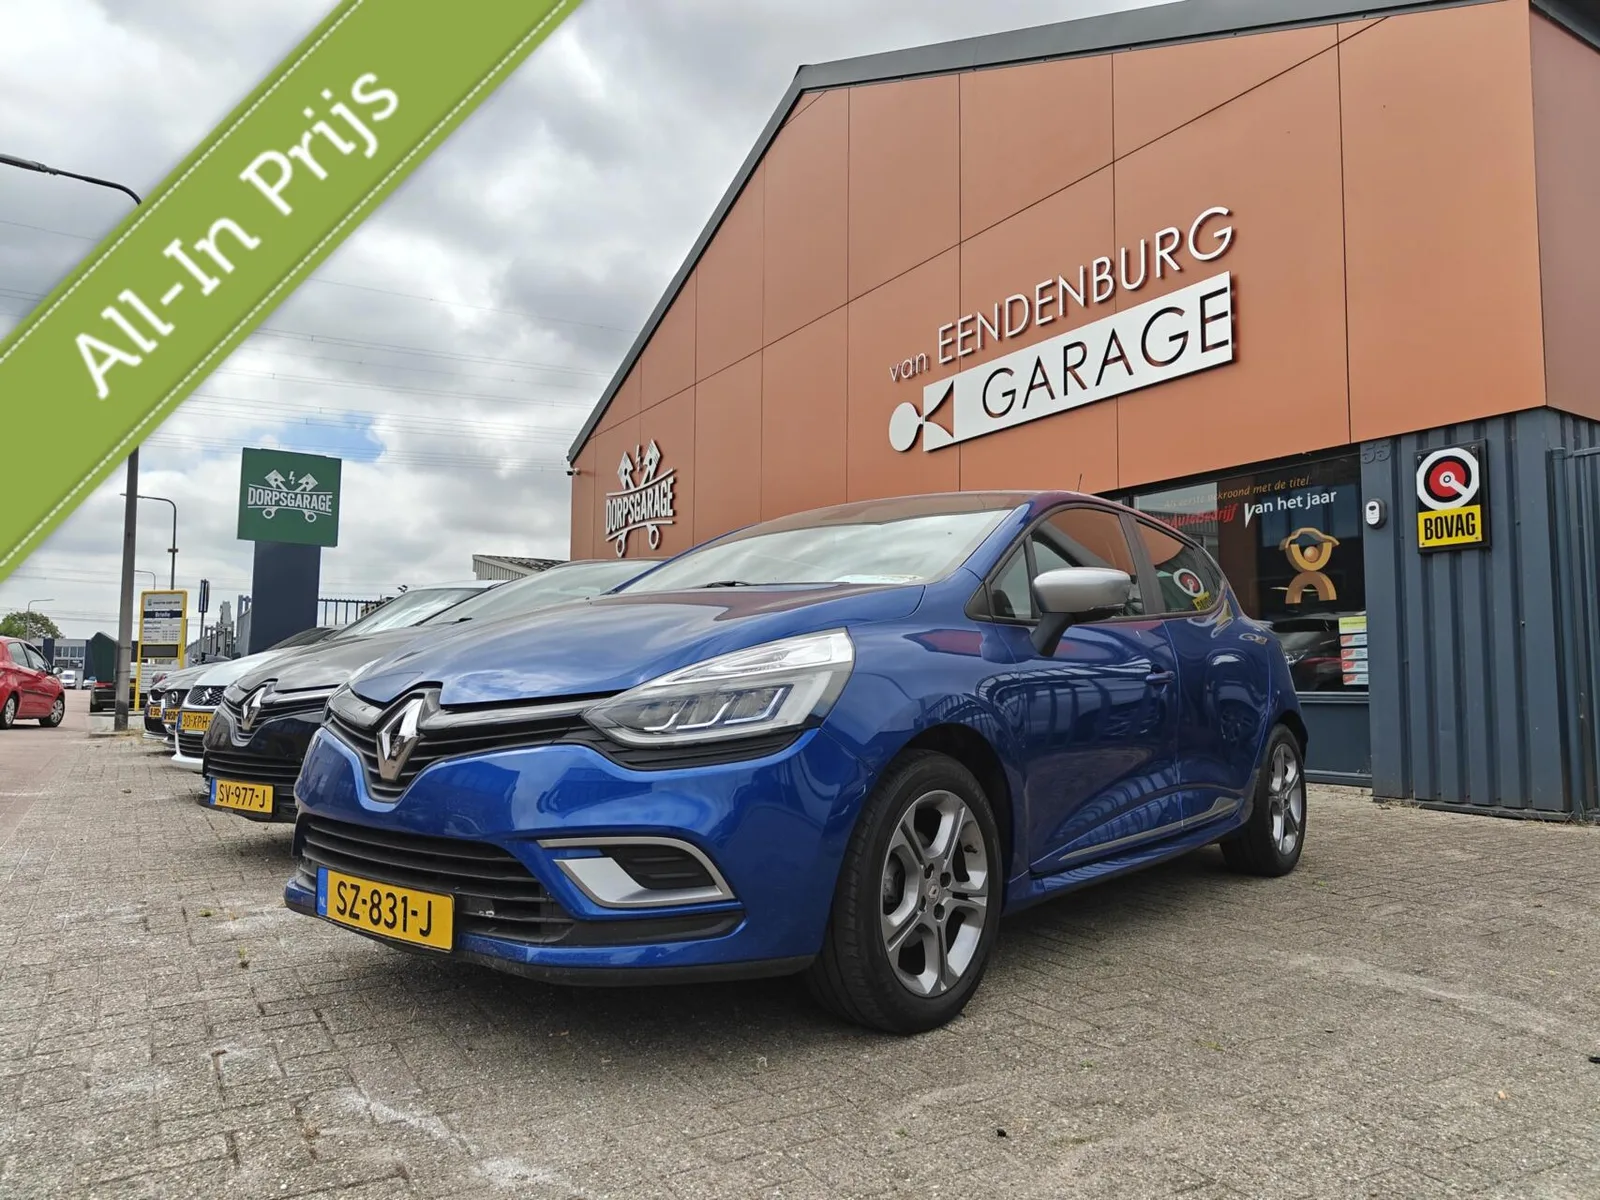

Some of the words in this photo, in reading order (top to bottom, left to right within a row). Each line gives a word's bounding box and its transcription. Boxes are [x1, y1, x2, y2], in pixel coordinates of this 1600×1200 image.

[889, 351, 929, 382] van
[937, 205, 1234, 365] EENDENBURG
[981, 286, 1230, 419] GARAGE
[247, 486, 333, 512] DORPSGARAGE
[1253, 483, 1272, 494] met
[1274, 480, 1287, 490] de
[1277, 496, 1303, 511] het
[1305, 491, 1337, 510] jaar
[606, 475, 675, 534] DORPSGARAGE
[1423, 512, 1476, 541] BOVAG
[218, 783, 266, 809] SV-977-J
[336, 880, 432, 937] SZ-831-J
